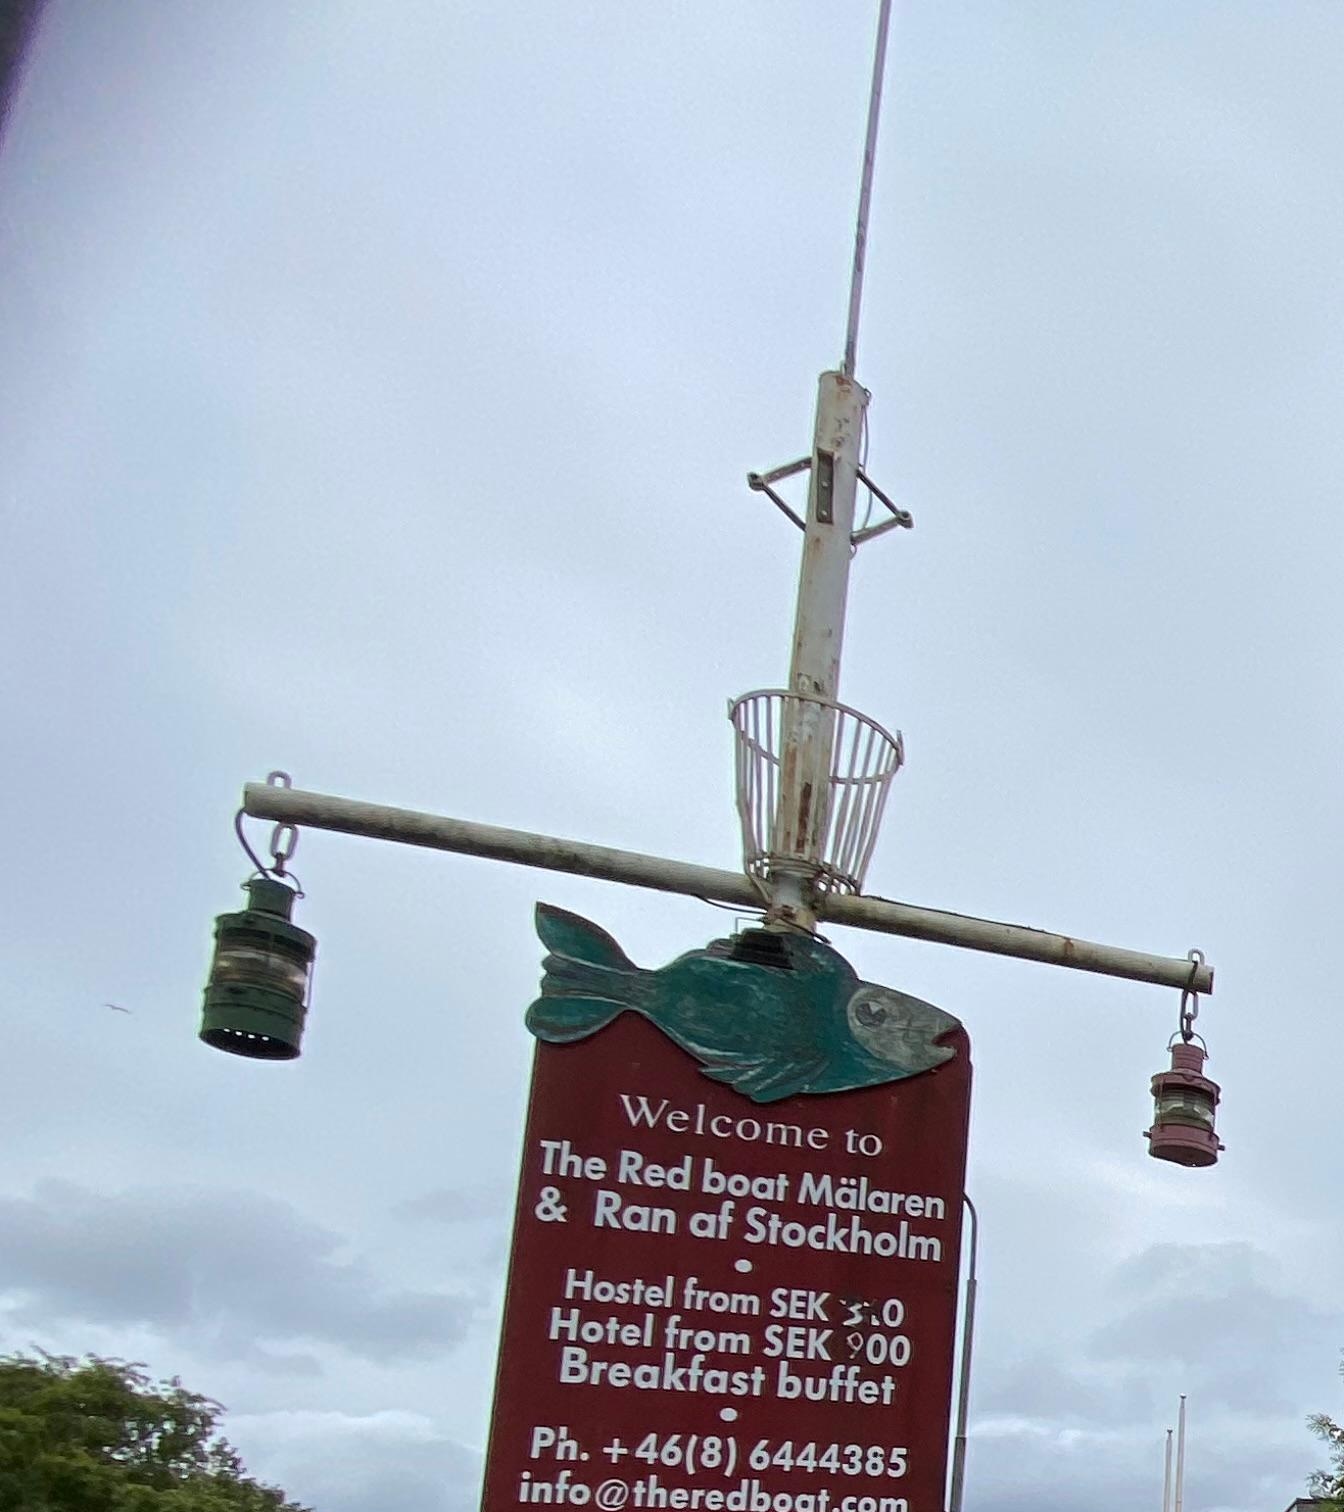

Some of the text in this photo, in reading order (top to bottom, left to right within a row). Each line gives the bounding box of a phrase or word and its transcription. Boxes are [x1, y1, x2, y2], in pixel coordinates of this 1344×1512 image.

[620, 1094, 883, 1156] Welcome to
[540, 1140, 945, 1220] The Red boat Mälaren
[535, 1187, 943, 1262] & Ran af Stockholm
[565, 1269, 675, 1309] Hostel
[683, 1277, 760, 1315] from
[769, 1287, 831, 1322] SEK
[549, 1307, 655, 1347] Hotel
[664, 1315, 749, 1355] from
[763, 1324, 833, 1361] SEK
[559, 1346, 895, 1405] Breakfast buffet
[530, 1426, 907, 1478] Ph. +46(8) 6444385
